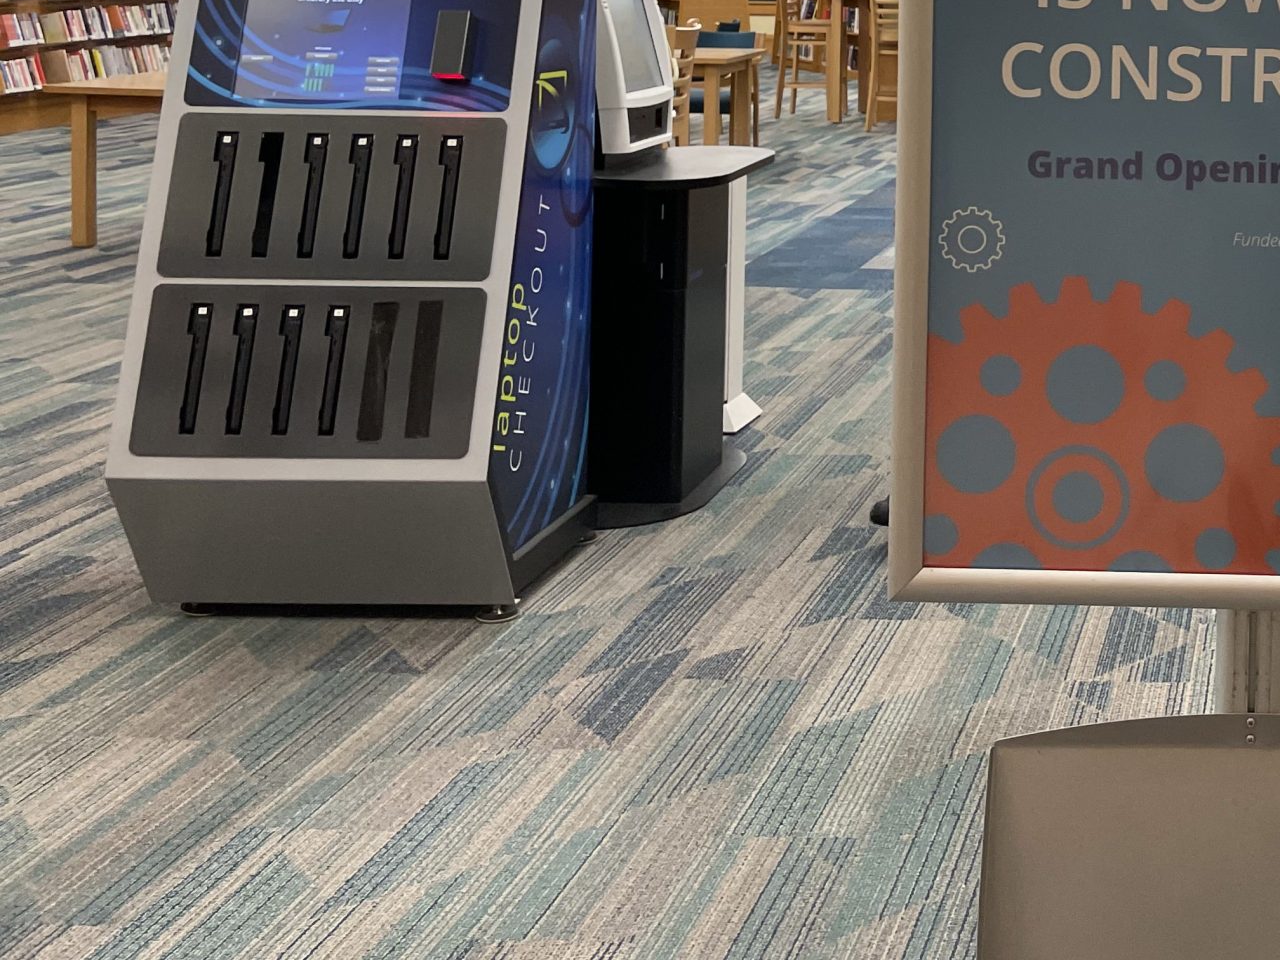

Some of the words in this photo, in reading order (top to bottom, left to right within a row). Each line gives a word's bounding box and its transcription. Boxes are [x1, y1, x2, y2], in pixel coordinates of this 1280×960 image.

[1027, 150, 1143, 181] Grand
[493, 283, 527, 451] laptop
[509, 194, 550, 472] CHECKOUT
